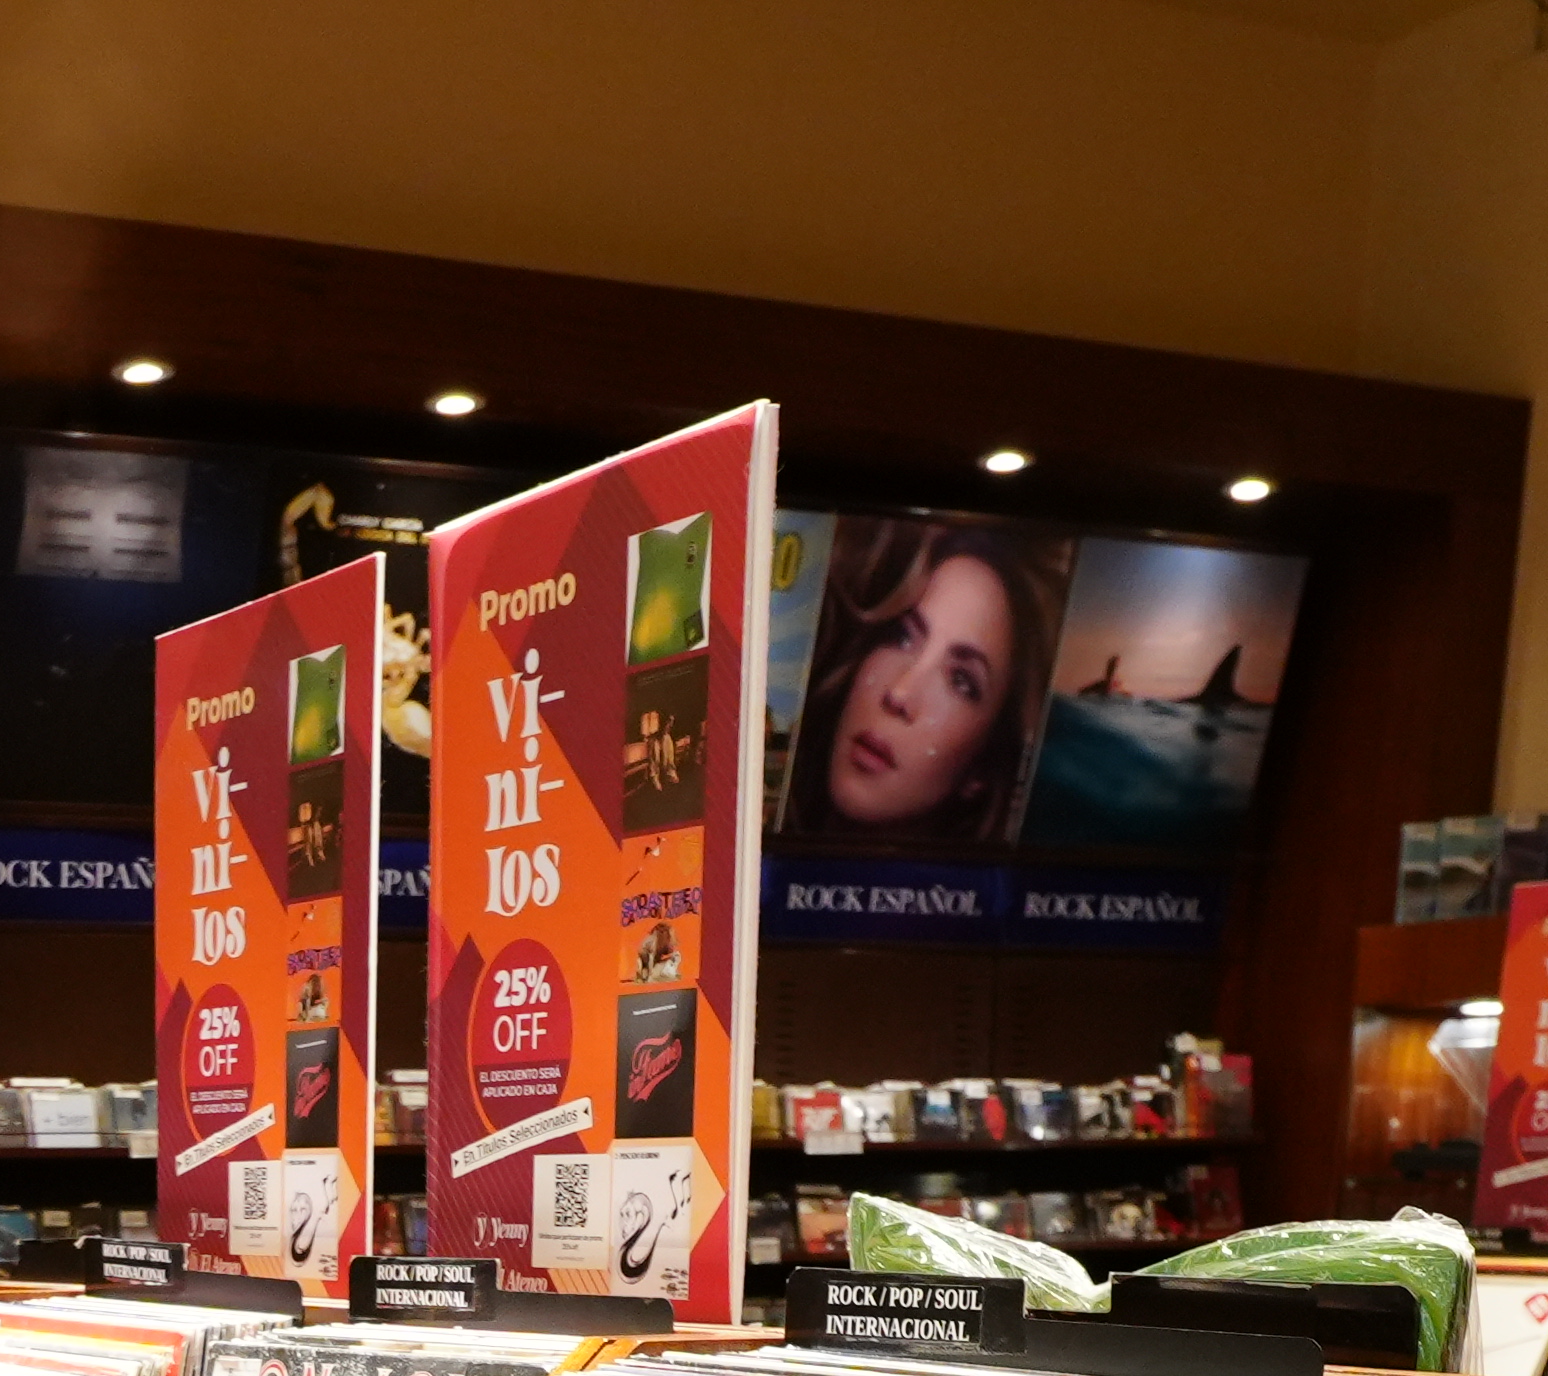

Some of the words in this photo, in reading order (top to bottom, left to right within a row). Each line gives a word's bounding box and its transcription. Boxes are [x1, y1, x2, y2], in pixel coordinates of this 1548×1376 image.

[480, 572, 576, 631] Promo
[186, 687, 255, 731] Promo
[59, 856, 156, 891] ESPAÑ
[787, 883, 863, 912] ROCK
[868, 883, 982, 919] ESPAÑOL
[1025, 890, 1094, 919] ROCK
[1099, 891, 1204, 923] ESPAÑOL
[493, 965, 551, 1008] 25%
[199, 1005, 241, 1040] 25%
[493, 1011, 547, 1052] OFF
[199, 1045, 238, 1077] OFF
[491, 1067, 538, 1082] DESCUENTO
[482, 1082, 523, 1098] APLICADO
[524, 1082, 535, 1096] EN
[536, 1080, 558, 1096] CAJA
[463, 1149, 475, 1166] En
[508, 1108, 579, 1149] Seleccionados
[103, 1243, 127, 1260] ROCK
[129, 1246, 147, 1261] POP
[151, 1248, 172, 1263] SOUL
[103, 1263, 168, 1282] INTERNACIONAL
[376, 1264, 410, 1282] ROCK
[416, 1266, 438, 1282] POP
[444, 1267, 475, 1284] SOUL
[376, 1287, 469, 1308] INTERNACIONAL
[828, 1284, 878, 1308] ROCK
[889, 1287, 923, 1309] POP
[934, 1289, 982, 1312] SOUL
[825, 1314, 971, 1343] INTERNACIONAL
